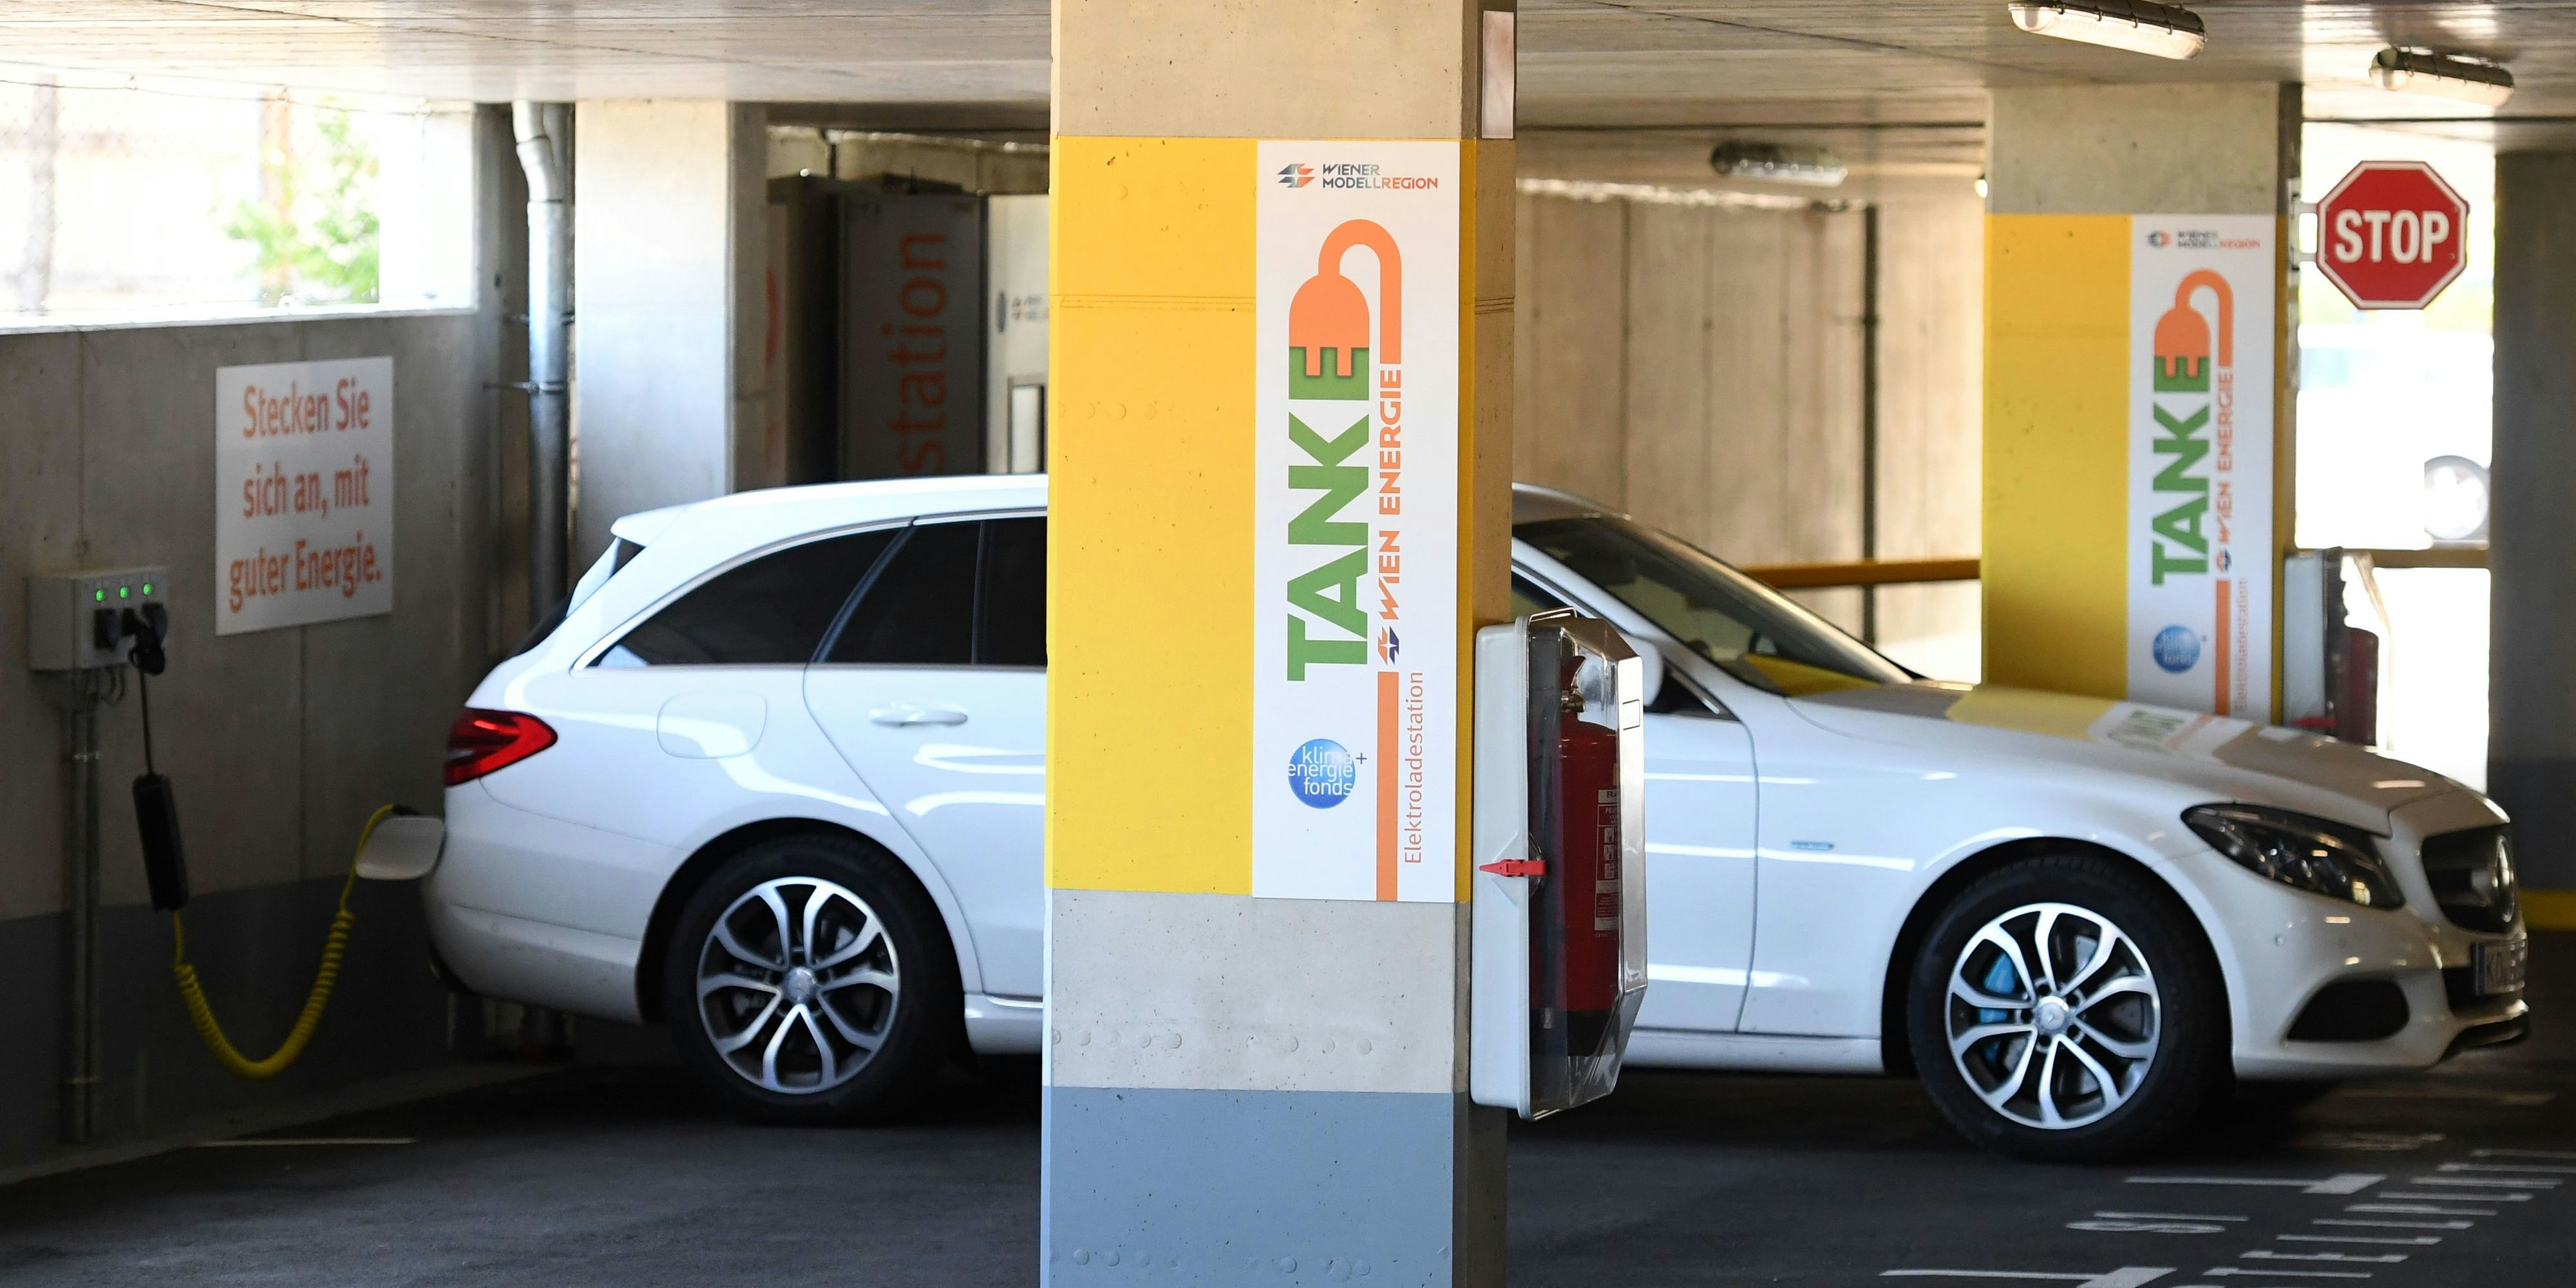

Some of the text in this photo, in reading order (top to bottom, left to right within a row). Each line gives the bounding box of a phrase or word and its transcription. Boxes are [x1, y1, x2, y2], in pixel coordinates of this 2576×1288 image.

[1322, 163, 1381, 176] WIENER
[1322, 176, 1439, 190] MODELLREGION
[2334, 207, 2450, 265] STOP
[243, 377, 370, 439] Stecken Sie
[2217, 372, 2233, 472] ENERGIE
[243, 453, 370, 520] sich an, mit
[1378, 370, 1403, 620] WIEN ENERGIE
[2152, 355, 2211, 587] TANKE
[1287, 346, 1370, 682] TANKE
[229, 530, 383, 613] guter Energie.
[1288, 763, 1354, 782] energie
[1302, 745, 1352, 764] klima
[1403, 672, 1424, 864] Elektroladestation
[1303, 777, 1354, 797] fonds
